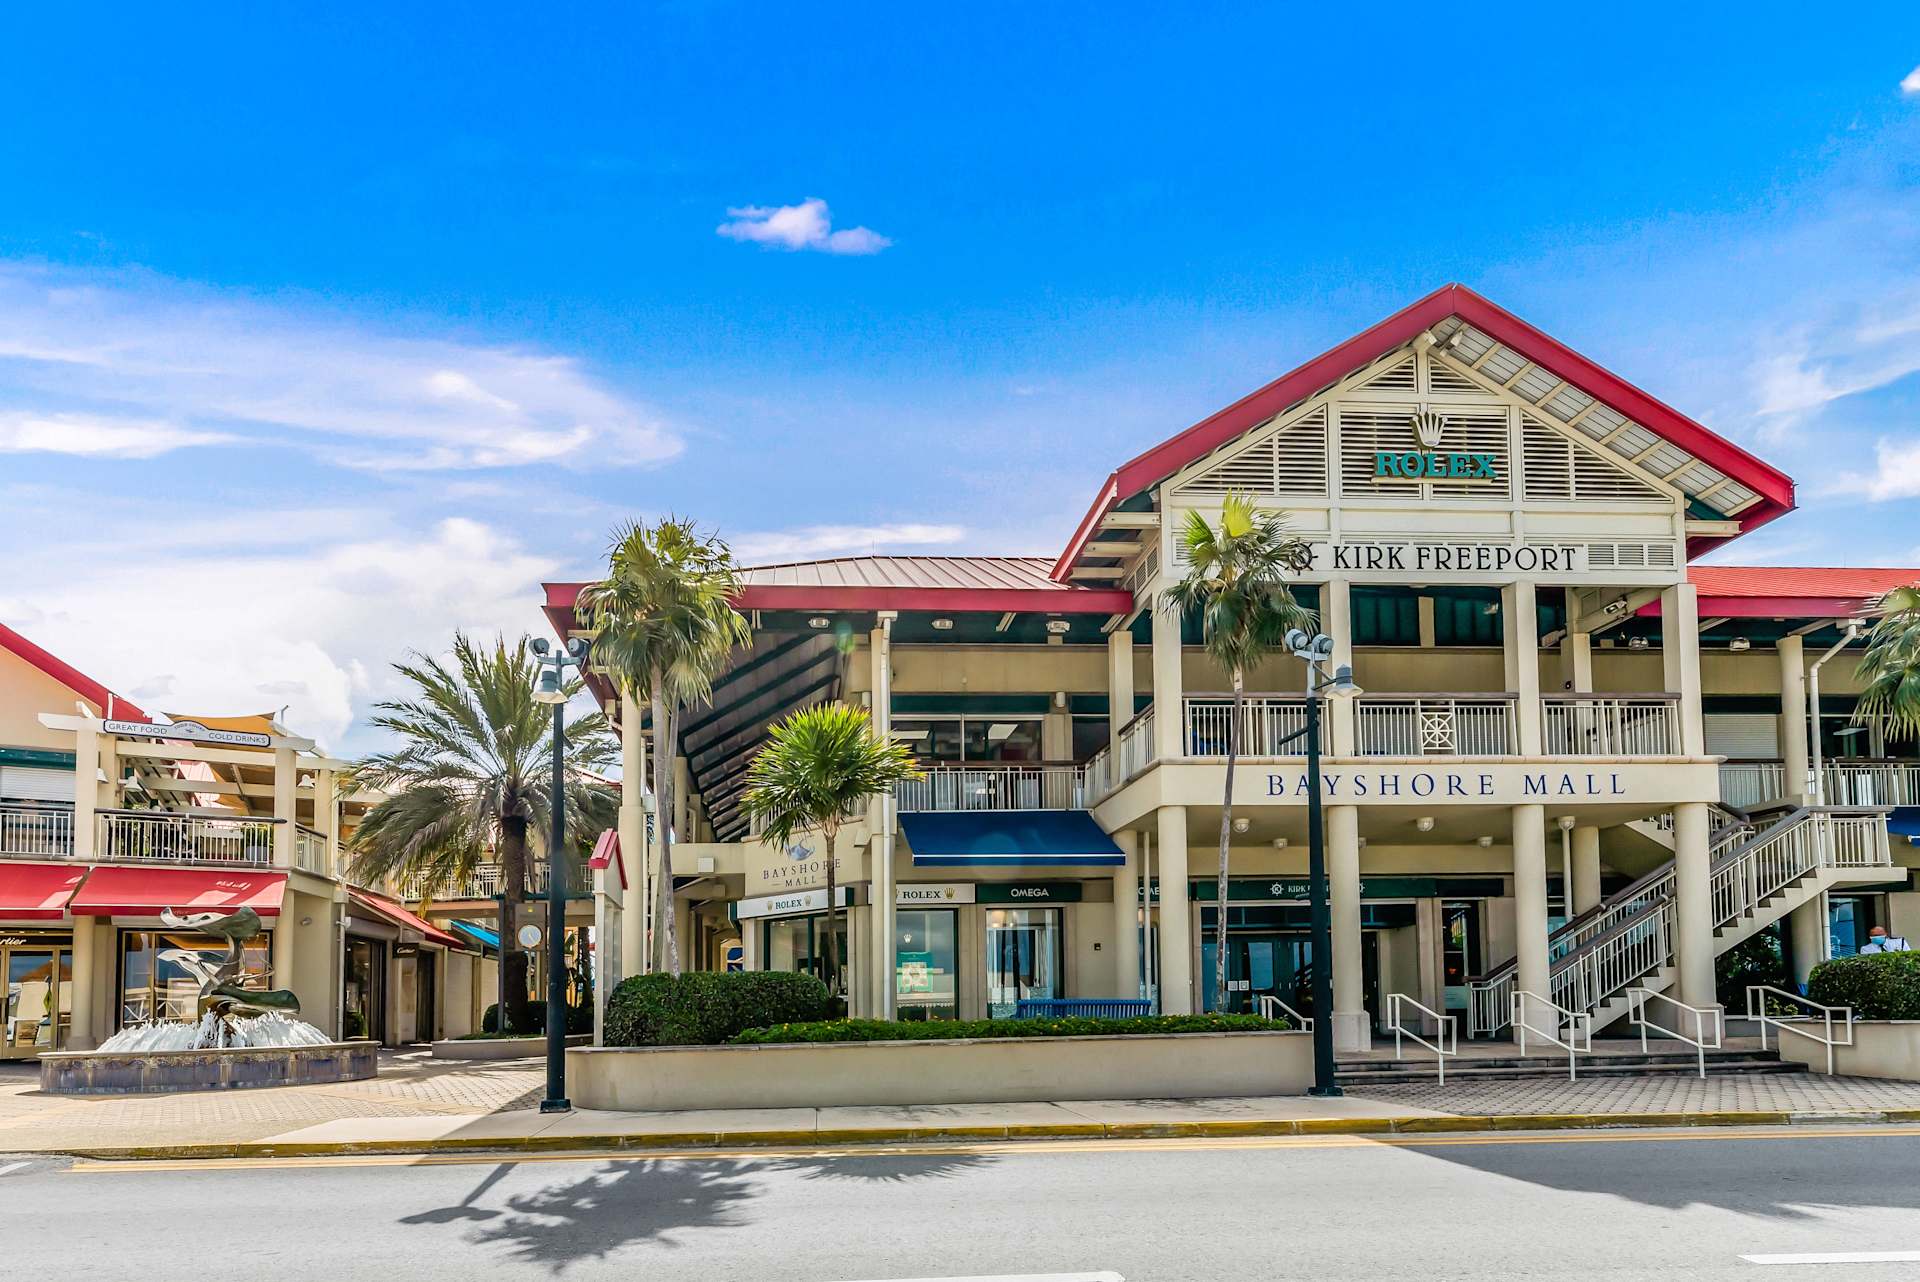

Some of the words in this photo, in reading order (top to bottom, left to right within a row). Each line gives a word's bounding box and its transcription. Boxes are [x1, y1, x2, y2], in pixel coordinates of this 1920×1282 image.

[1375, 452, 1497, 478] ROLEX
[1333, 545, 1405, 569] KIRK
[1416, 547, 1576, 570] FREEPORT
[108, 723, 137, 732] GREAT
[140, 725, 168, 735] FOOD
[208, 732, 233, 741] COLD
[235, 735, 266, 744] DRINKS
[1266, 773, 1495, 797] BAYSHORE
[1523, 773, 1625, 796] MALL
[785, 875, 817, 887] MALL
[903, 890, 941, 899] ROLEX
[1010, 888, 1049, 897] OMEGA
[775, 899, 802, 910] ROLEX
